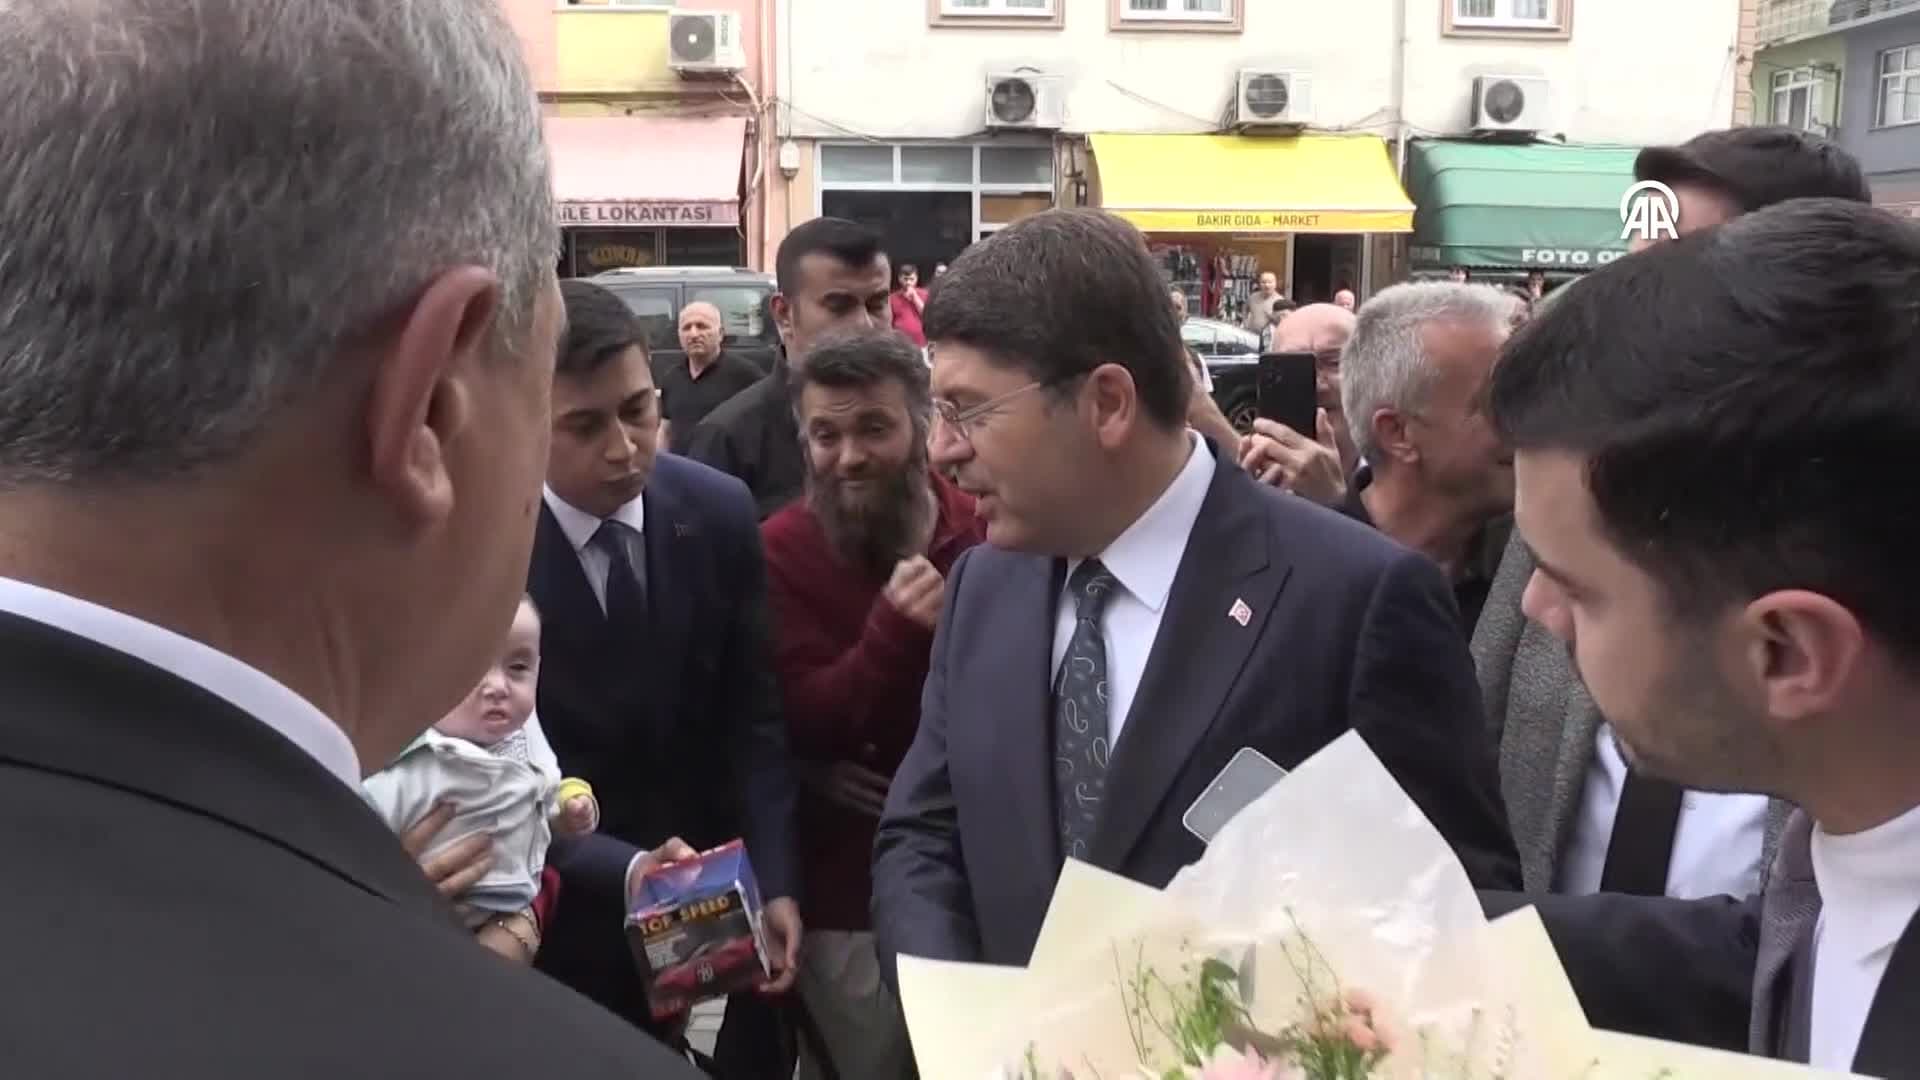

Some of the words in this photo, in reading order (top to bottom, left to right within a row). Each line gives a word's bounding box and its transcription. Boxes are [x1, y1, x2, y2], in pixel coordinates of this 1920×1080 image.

[1272, 214, 1320, 226] MARKET
[1521, 249, 1589, 264] FOTO
[679, 896, 730, 922] SPEED
